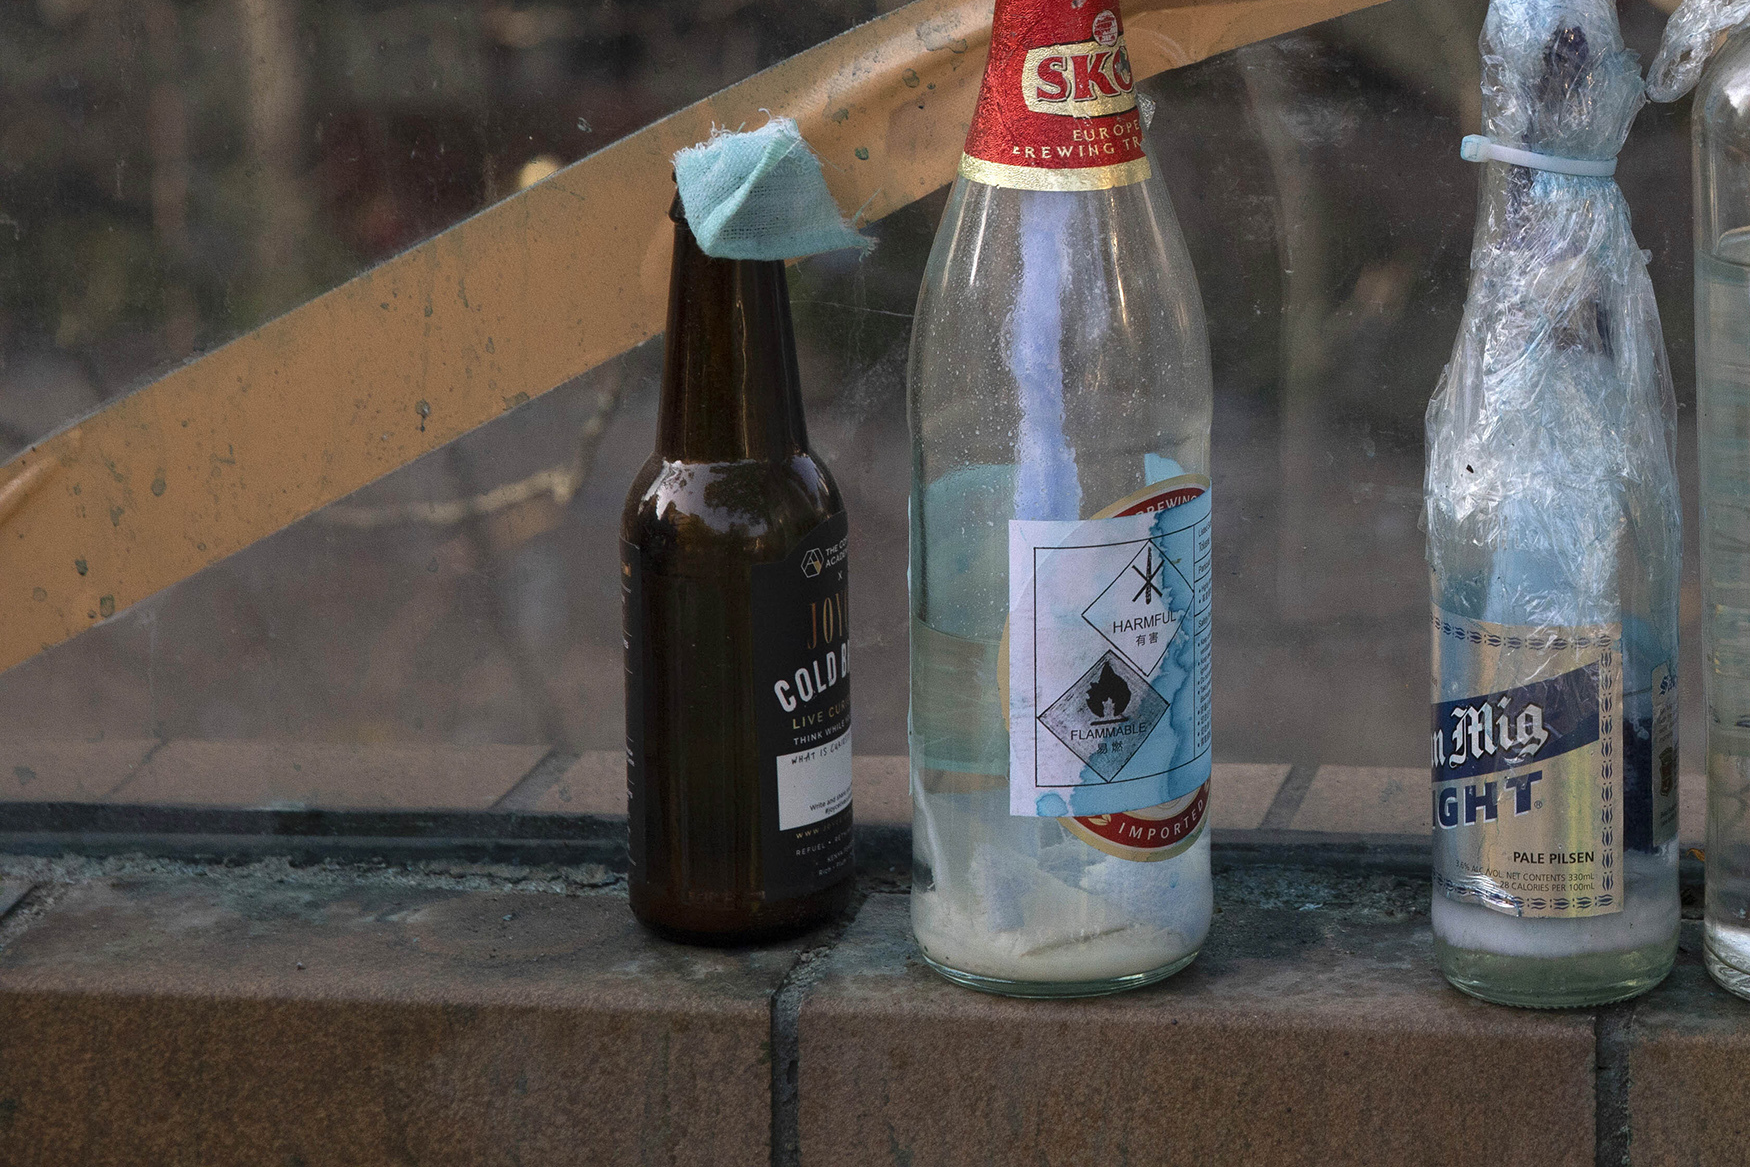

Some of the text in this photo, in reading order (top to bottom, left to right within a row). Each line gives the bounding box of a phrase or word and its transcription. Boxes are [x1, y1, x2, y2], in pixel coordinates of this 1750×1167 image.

[1113, 610, 1176, 634] HARMFUL
[1135, 632, 1159, 647] 有害
[774, 651, 837, 712] COLD
[792, 711, 823, 730] LIVE
[793, 731, 822, 746] THINK
[1070, 722, 1147, 741] FLAMMABLE
[1448, 695, 1549, 769] Mig
[791, 746, 828, 765] WHAT IS
[1097, 741, 1123, 755] 易燃
[1118, 799, 1203, 840] IMPORTED
[795, 843, 825, 856] REFUEL
[1513, 851, 1595, 864] PALE PILSEN
[1506, 872, 1595, 882] NET CONTENTS 330mL
[1511, 883, 1550, 892] CALORIES
[1552, 883, 1566, 892] PER
[1570, 882, 1595, 891] 100mL
